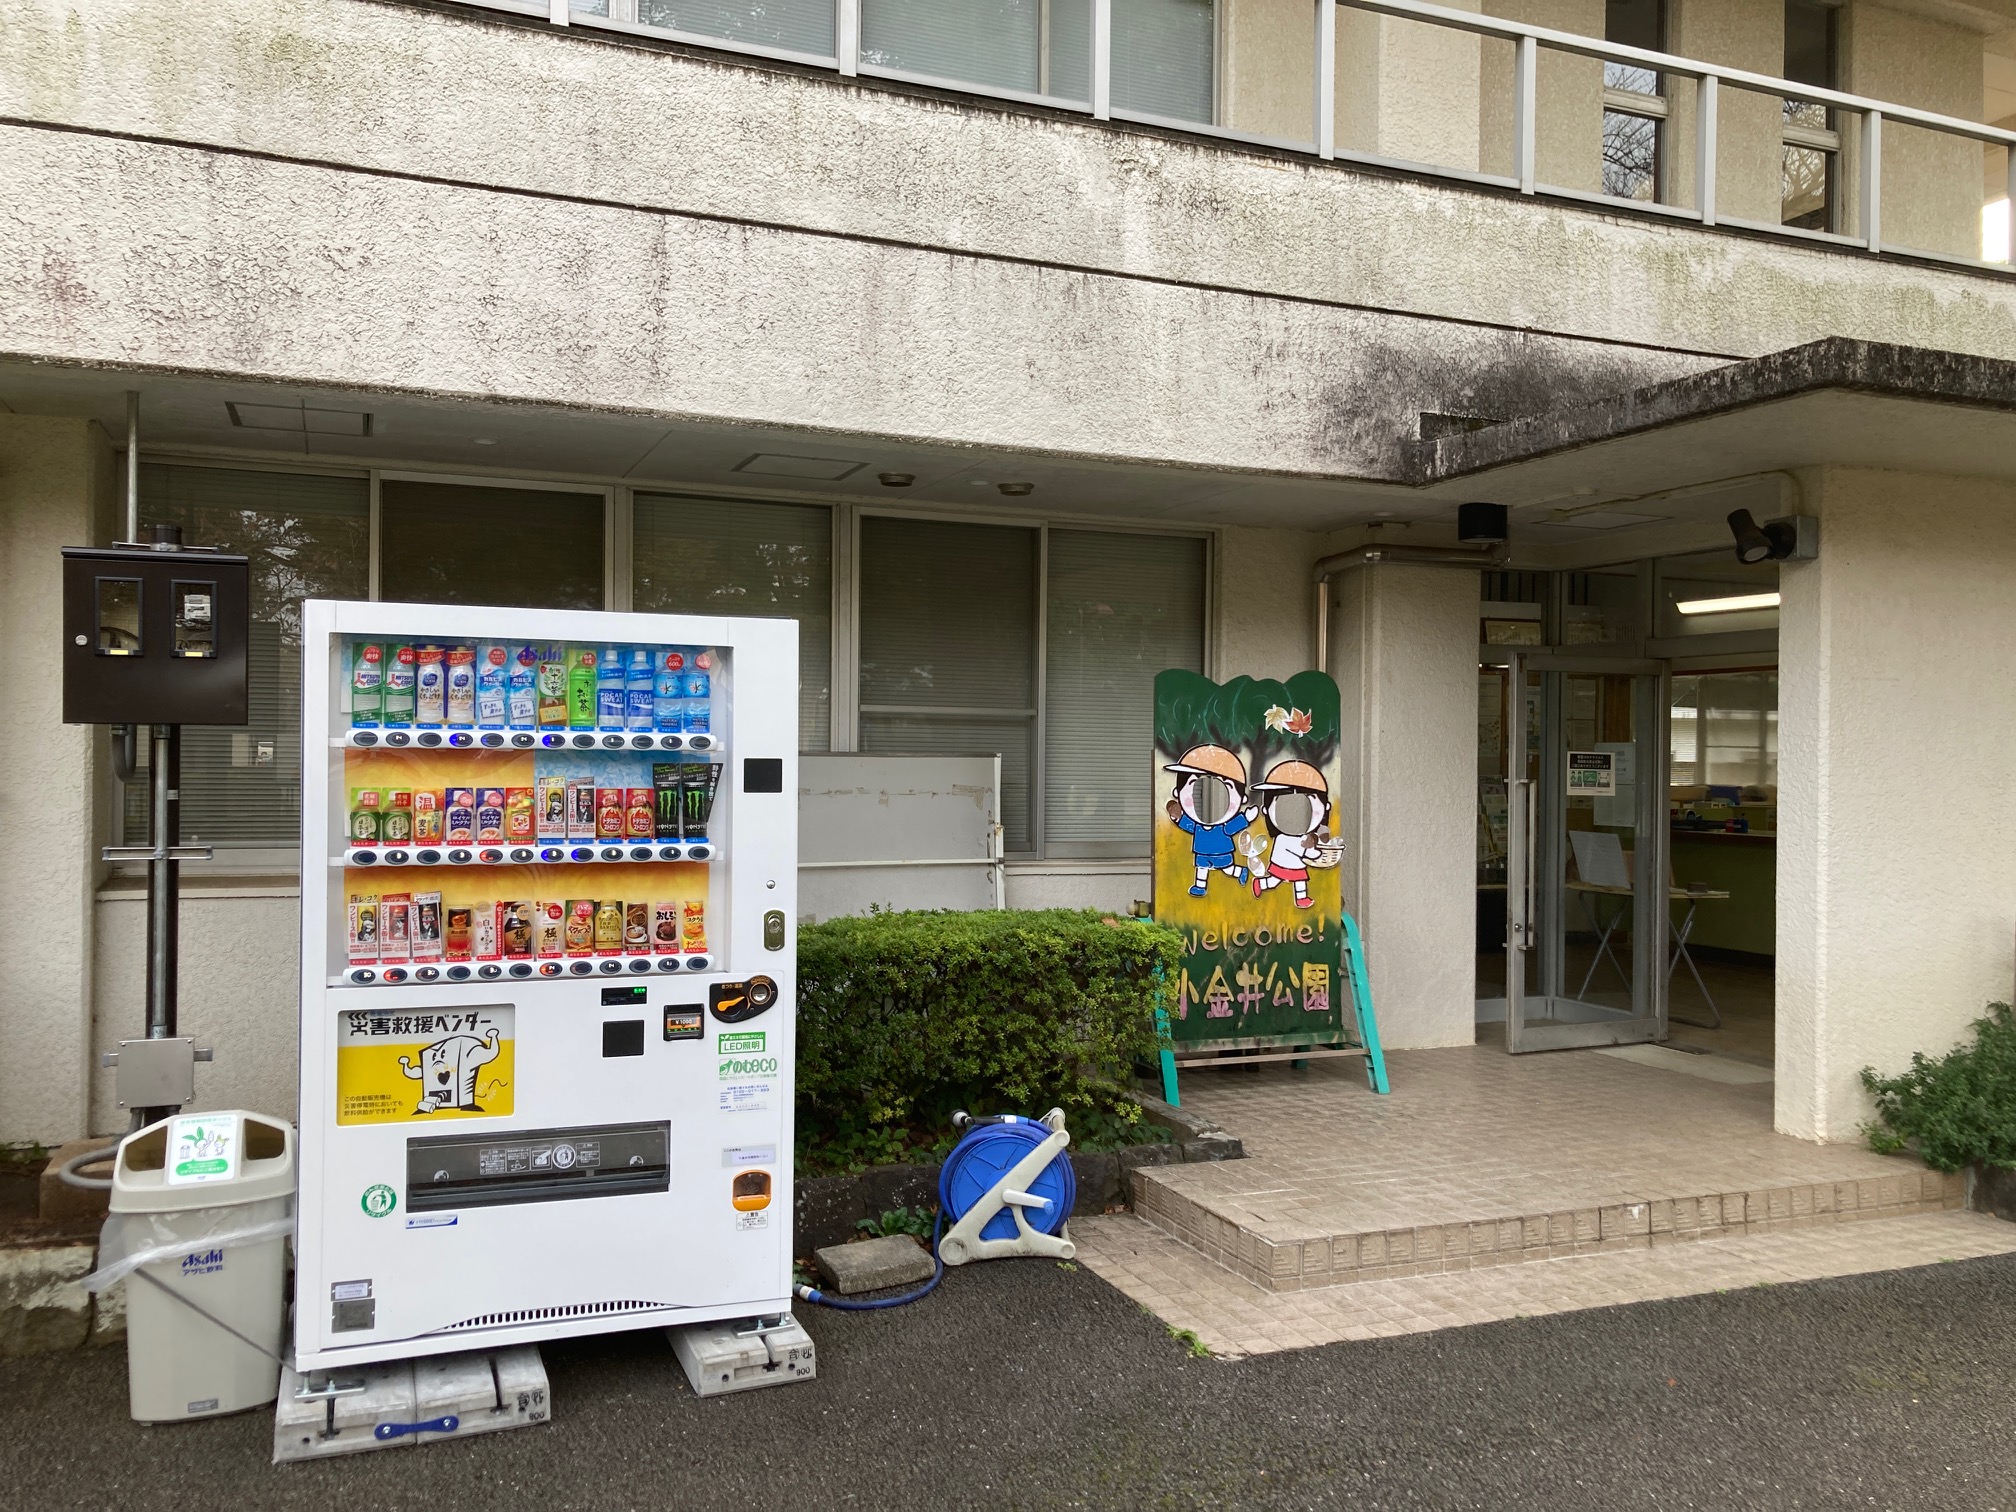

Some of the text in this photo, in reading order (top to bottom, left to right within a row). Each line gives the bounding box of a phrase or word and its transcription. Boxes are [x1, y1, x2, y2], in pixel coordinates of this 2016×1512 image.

[550, 673, 559, 695] 十六茶
[419, 797, 434, 810] 温
[418, 819, 427, 837] 麦茶
[482, 919, 490, 951] 白いカフェラテ
[514, 929, 526, 940] 極
[544, 927, 557, 938] 極
[1175, 961, 1330, 1020] 小金井公園
[347, 1011, 492, 1036] 災害救援ベンダー
[723, 1040, 760, 1051] LED照明
[344, 1094, 392, 1102] この自動販売機は
[344, 1100, 404, 1109] 災害停電時においても
[343, 1108, 397, 1117] 飲料供給ができます
[181, 1249, 224, 1268] Asahi
[796, 1367, 811, 1377] 900
